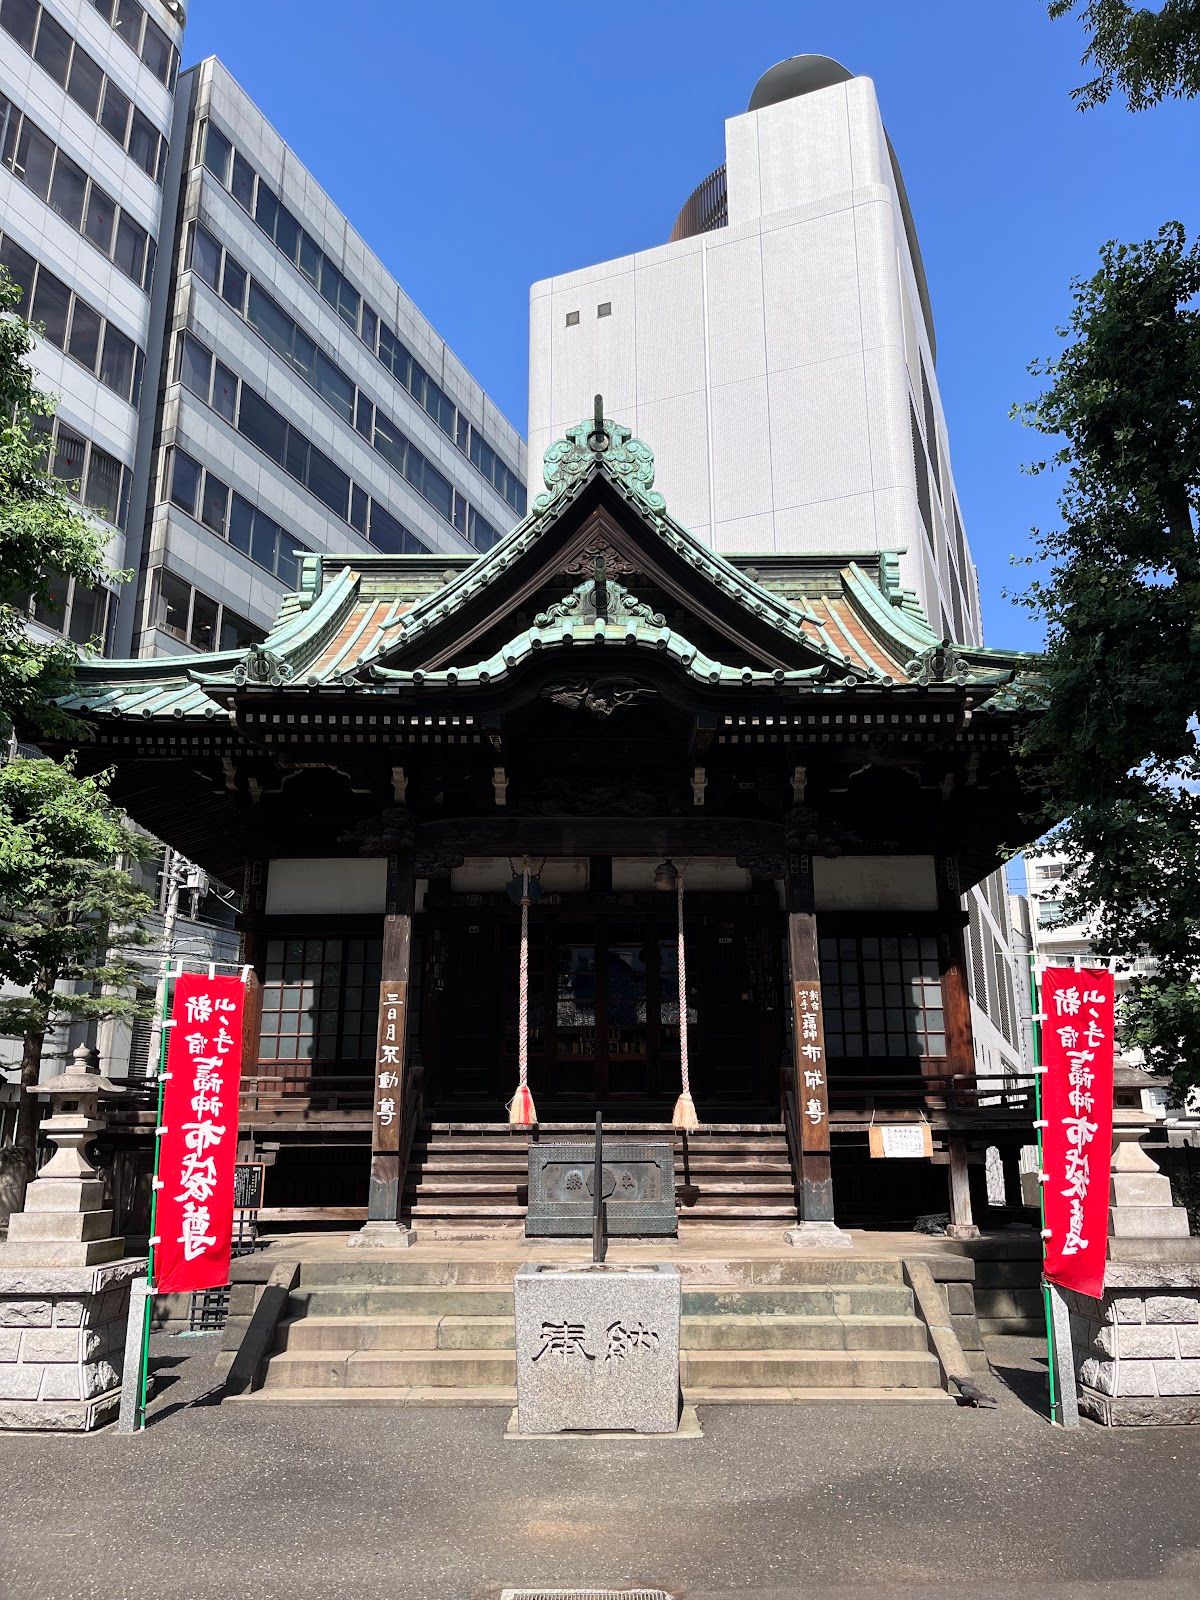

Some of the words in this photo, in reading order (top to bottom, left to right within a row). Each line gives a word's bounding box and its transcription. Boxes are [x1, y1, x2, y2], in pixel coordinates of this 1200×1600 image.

[375, 992, 404, 1126] 三日月不動尊
[531, 1320, 661, 1364] 奉納
